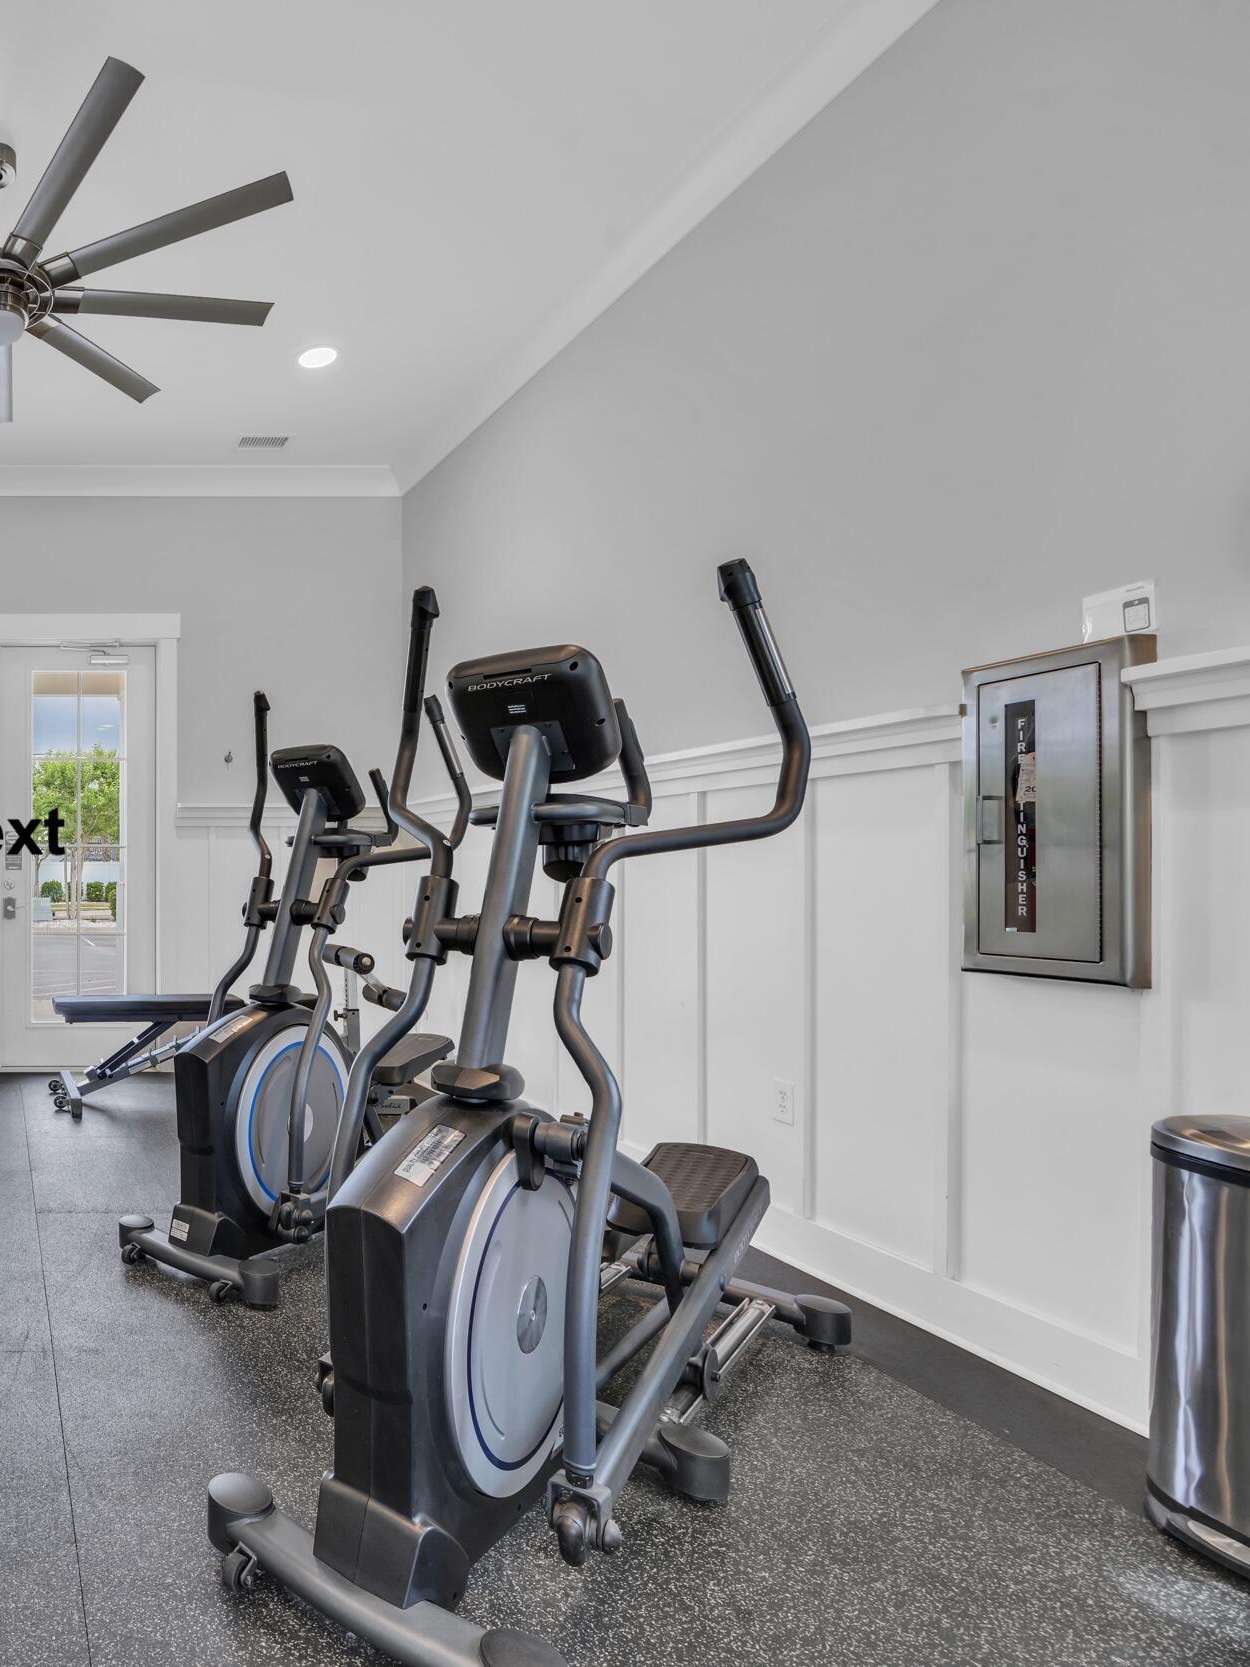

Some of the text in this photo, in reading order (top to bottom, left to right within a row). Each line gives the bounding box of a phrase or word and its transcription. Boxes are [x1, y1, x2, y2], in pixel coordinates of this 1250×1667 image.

[468, 673, 552, 692] BODYCRAFT
[1017, 718, 1026, 764] FIRE
[277, 760, 318, 769] BODYCRAFT
